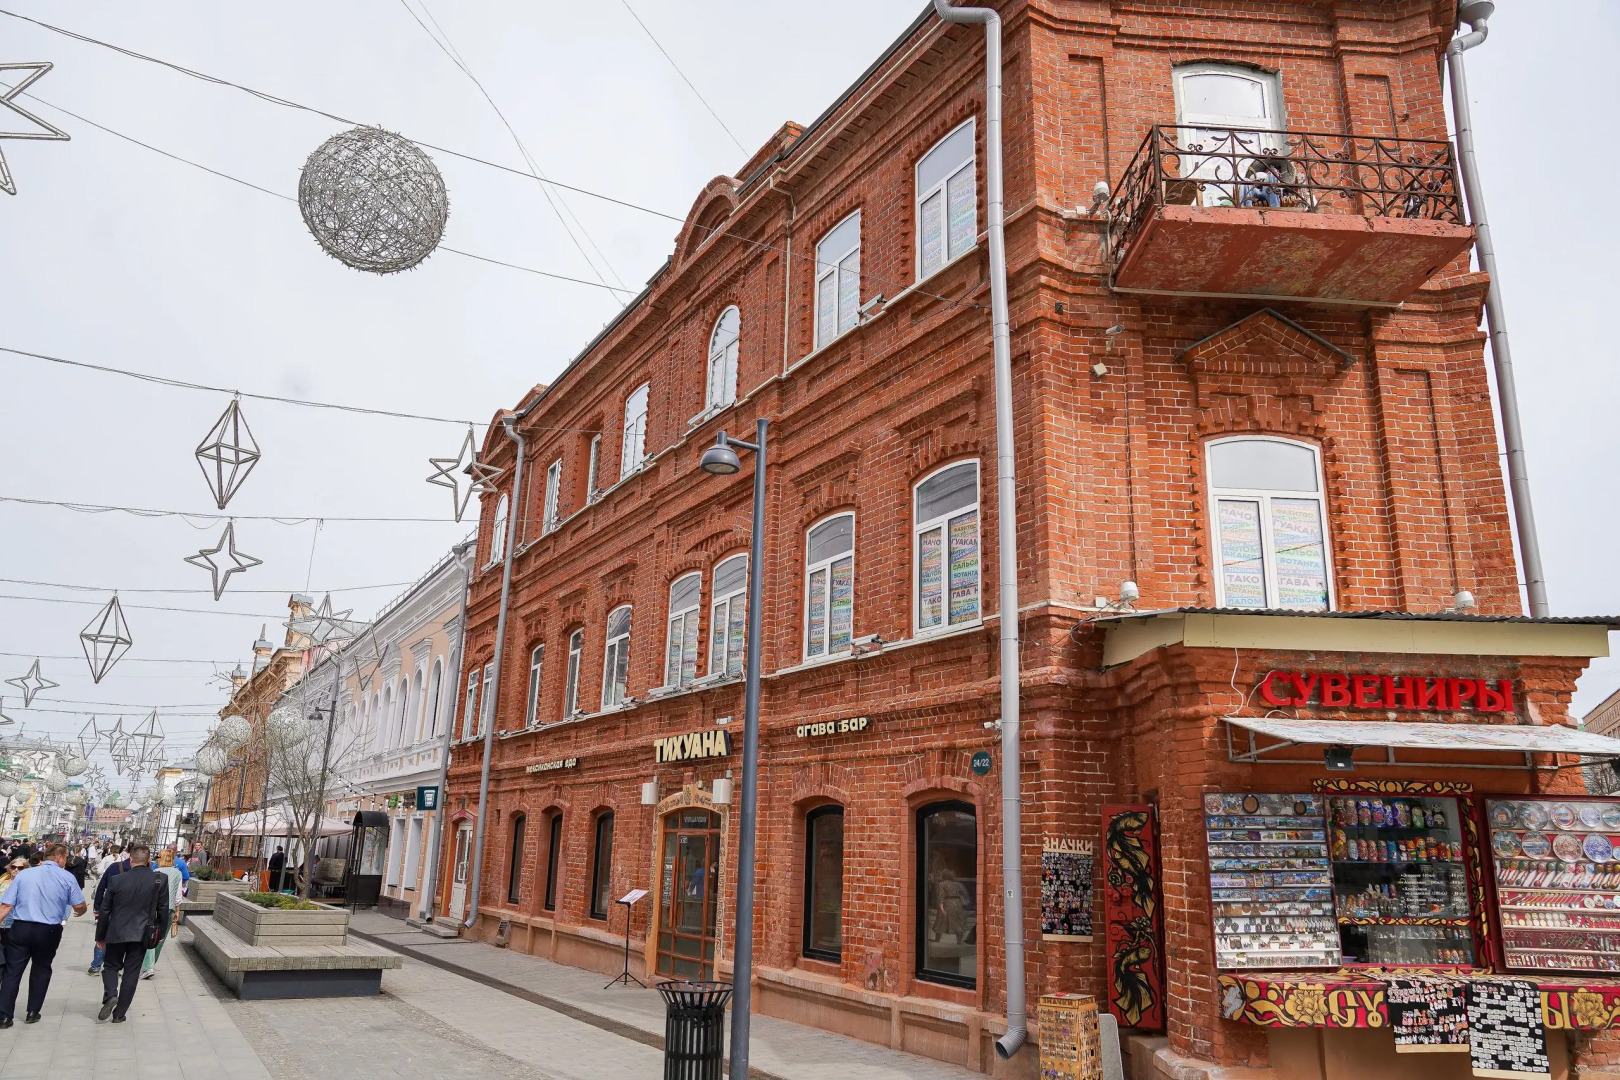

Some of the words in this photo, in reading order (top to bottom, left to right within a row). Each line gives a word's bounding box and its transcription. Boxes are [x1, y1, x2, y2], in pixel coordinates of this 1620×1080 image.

[1227, 574, 1260, 584] ТАКО
[1259, 669, 1515, 713] СУВЕНИРЫ
[796, 721, 836, 738] агава
[839, 717, 869, 733] бар
[653, 729, 729, 764] ТИХУАНА
[972, 757, 990, 768] 24/22
[1043, 836, 1093, 853] ЗНАЧКИ
